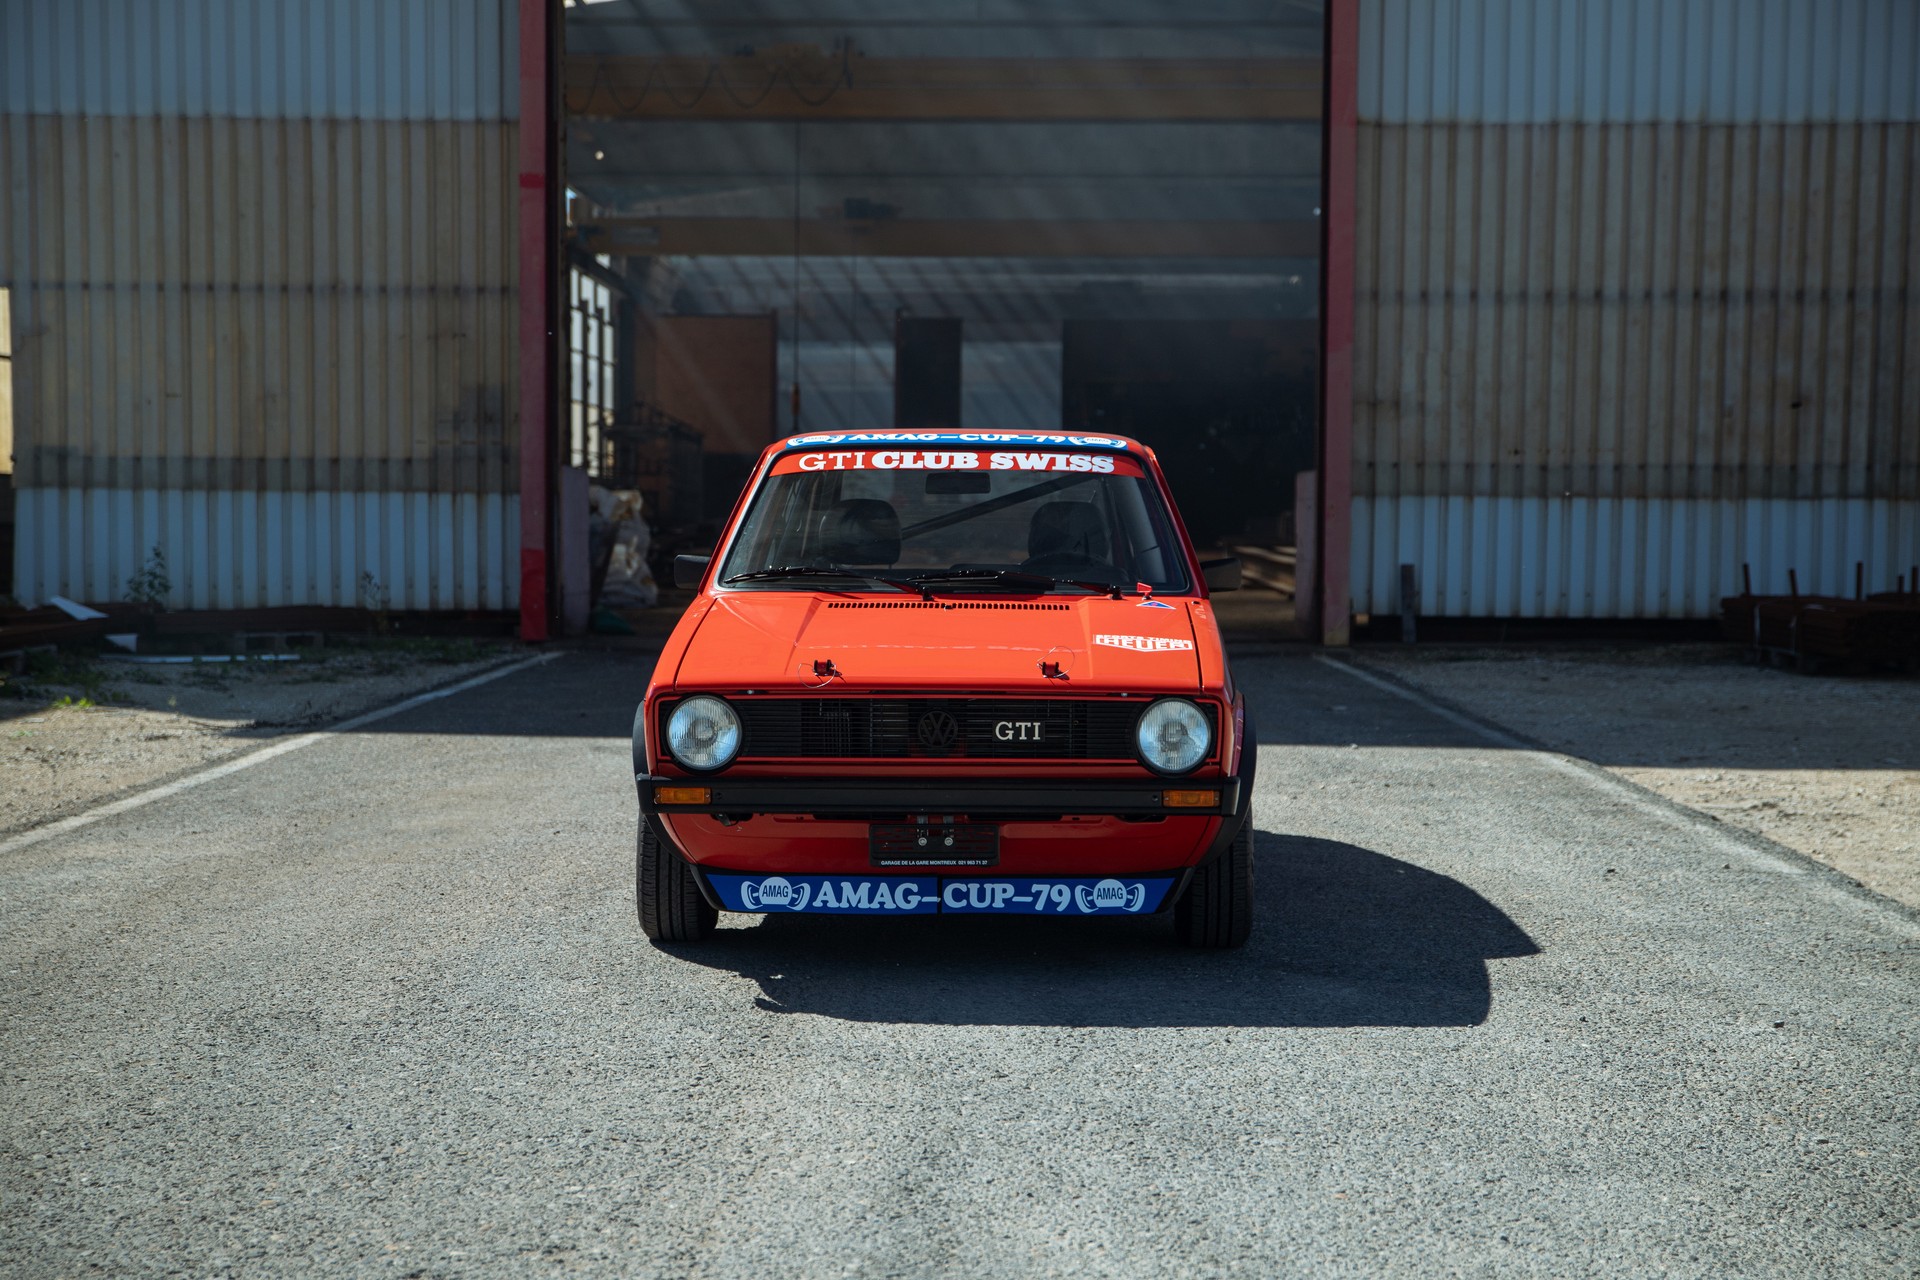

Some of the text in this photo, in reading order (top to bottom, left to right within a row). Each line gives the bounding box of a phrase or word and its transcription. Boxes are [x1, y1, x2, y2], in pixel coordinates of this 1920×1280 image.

[799, 451, 1115, 474] GTI CLUB SWISS
[995, 721, 1041, 741] GTI
[762, 884, 789, 898] AMAG
[1096, 886, 1124, 900] AMAG
